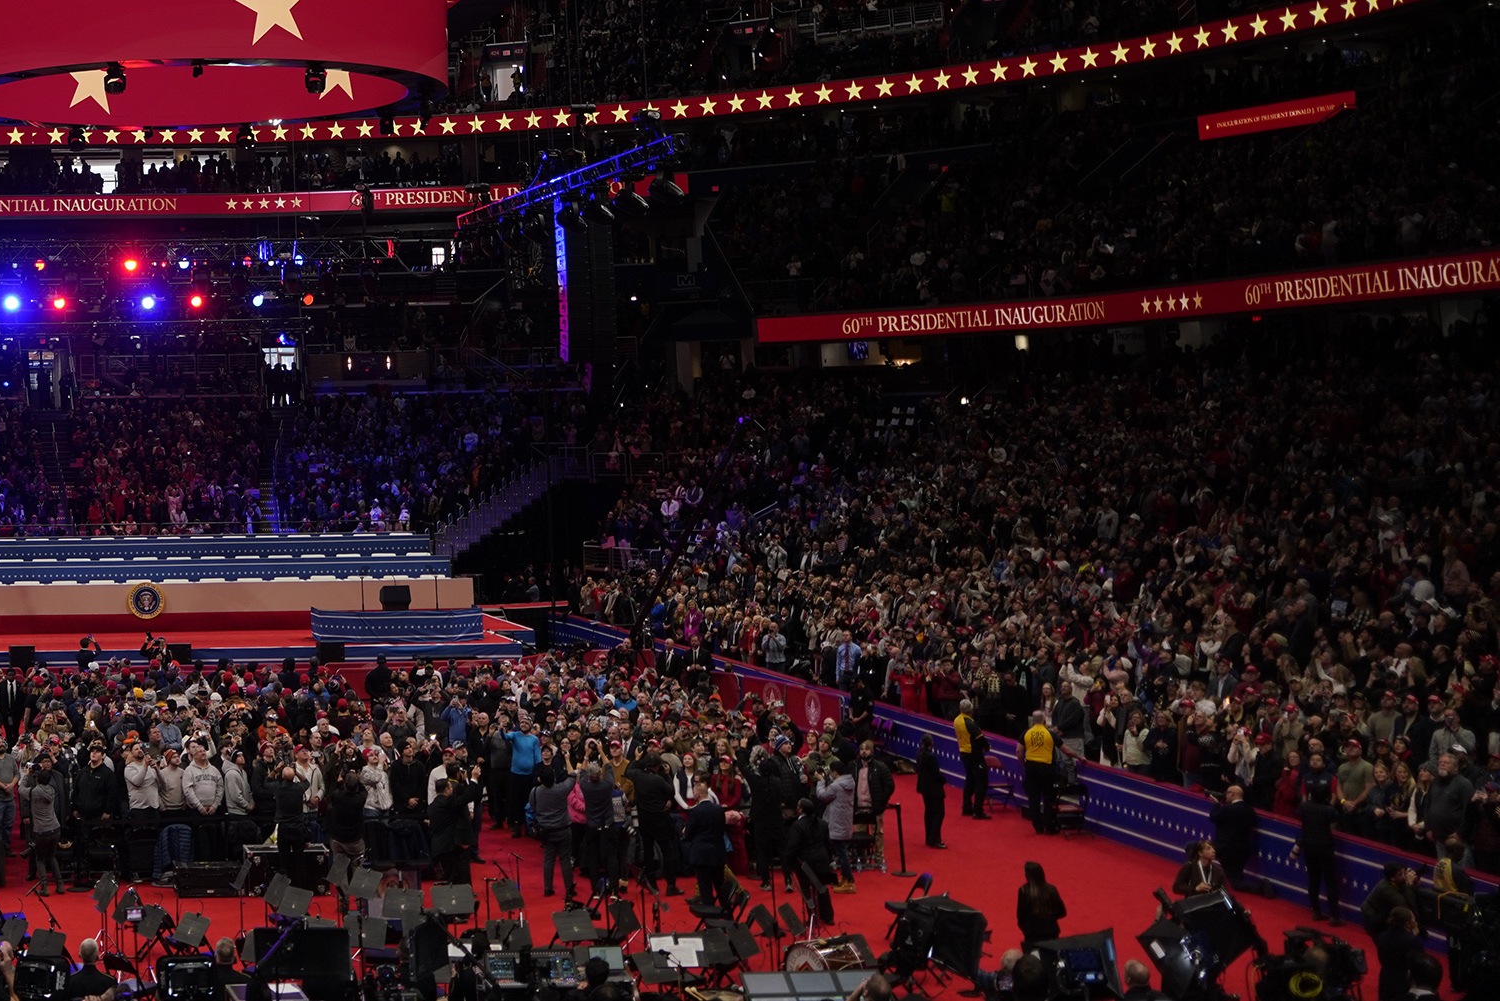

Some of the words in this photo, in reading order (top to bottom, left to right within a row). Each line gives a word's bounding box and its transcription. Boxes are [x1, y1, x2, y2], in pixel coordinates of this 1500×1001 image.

[1289, 107, 1311, 117] DONALD
[1316, 104, 1335, 113] TRUMP
[52, 197, 178, 213] INAUGURATION
[1245, 283, 1271, 305] 60TH
[1274, 270, 1394, 302] PRESIDENTIAL
[842, 316, 873, 334] 60TH
[878, 309, 991, 332] PRESIDENTIAL
[995, 301, 1105, 326] INAUGURATION
